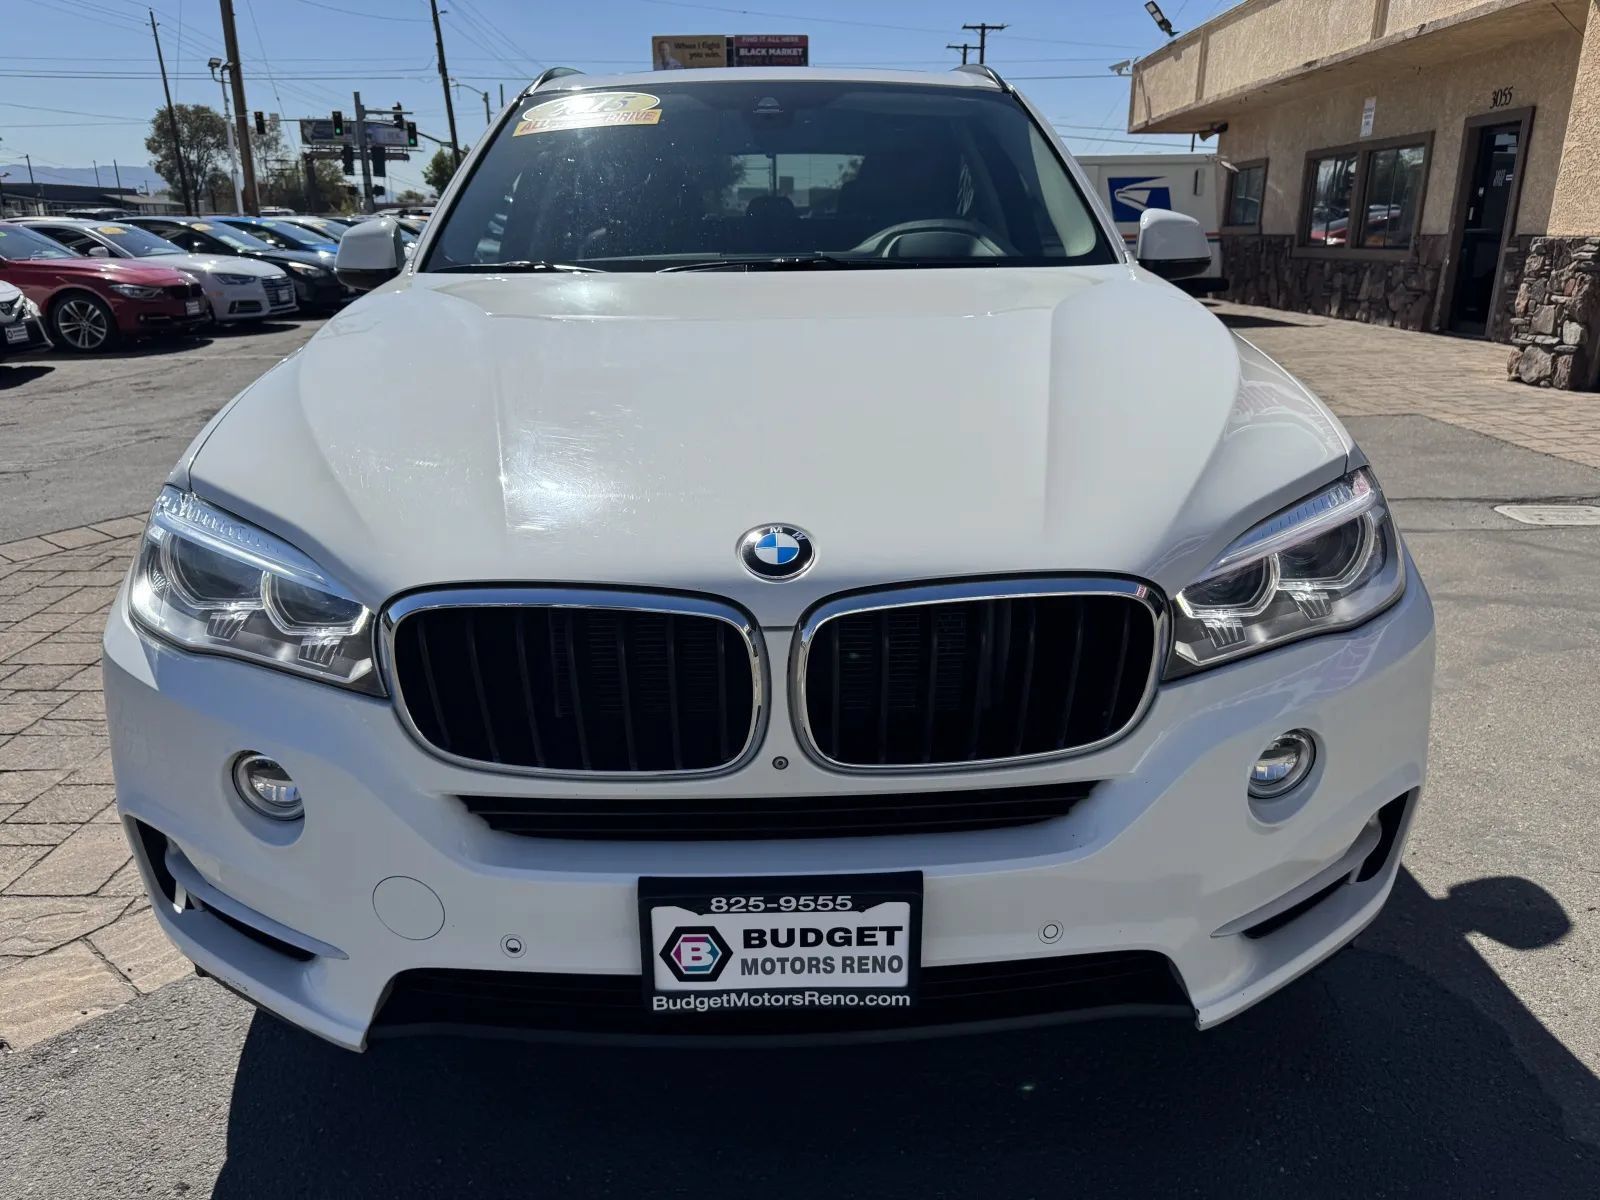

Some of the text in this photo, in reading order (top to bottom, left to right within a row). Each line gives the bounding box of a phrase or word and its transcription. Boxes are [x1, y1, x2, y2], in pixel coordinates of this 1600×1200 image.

[689, 52, 704, 60] you
[740, 47, 804, 56] BLACK MARKET
[1489, 85, 1514, 109] 3055
[520, 120, 549, 133] ALL
[605, 110, 657, 123] DRIVE
[710, 895, 853, 913] 825-9555
[742, 925, 904, 949] BUDGET
[740, 955, 904, 976] MOTORS RENO
[652, 991, 911, 1012] BudgetMotorsReno.com
